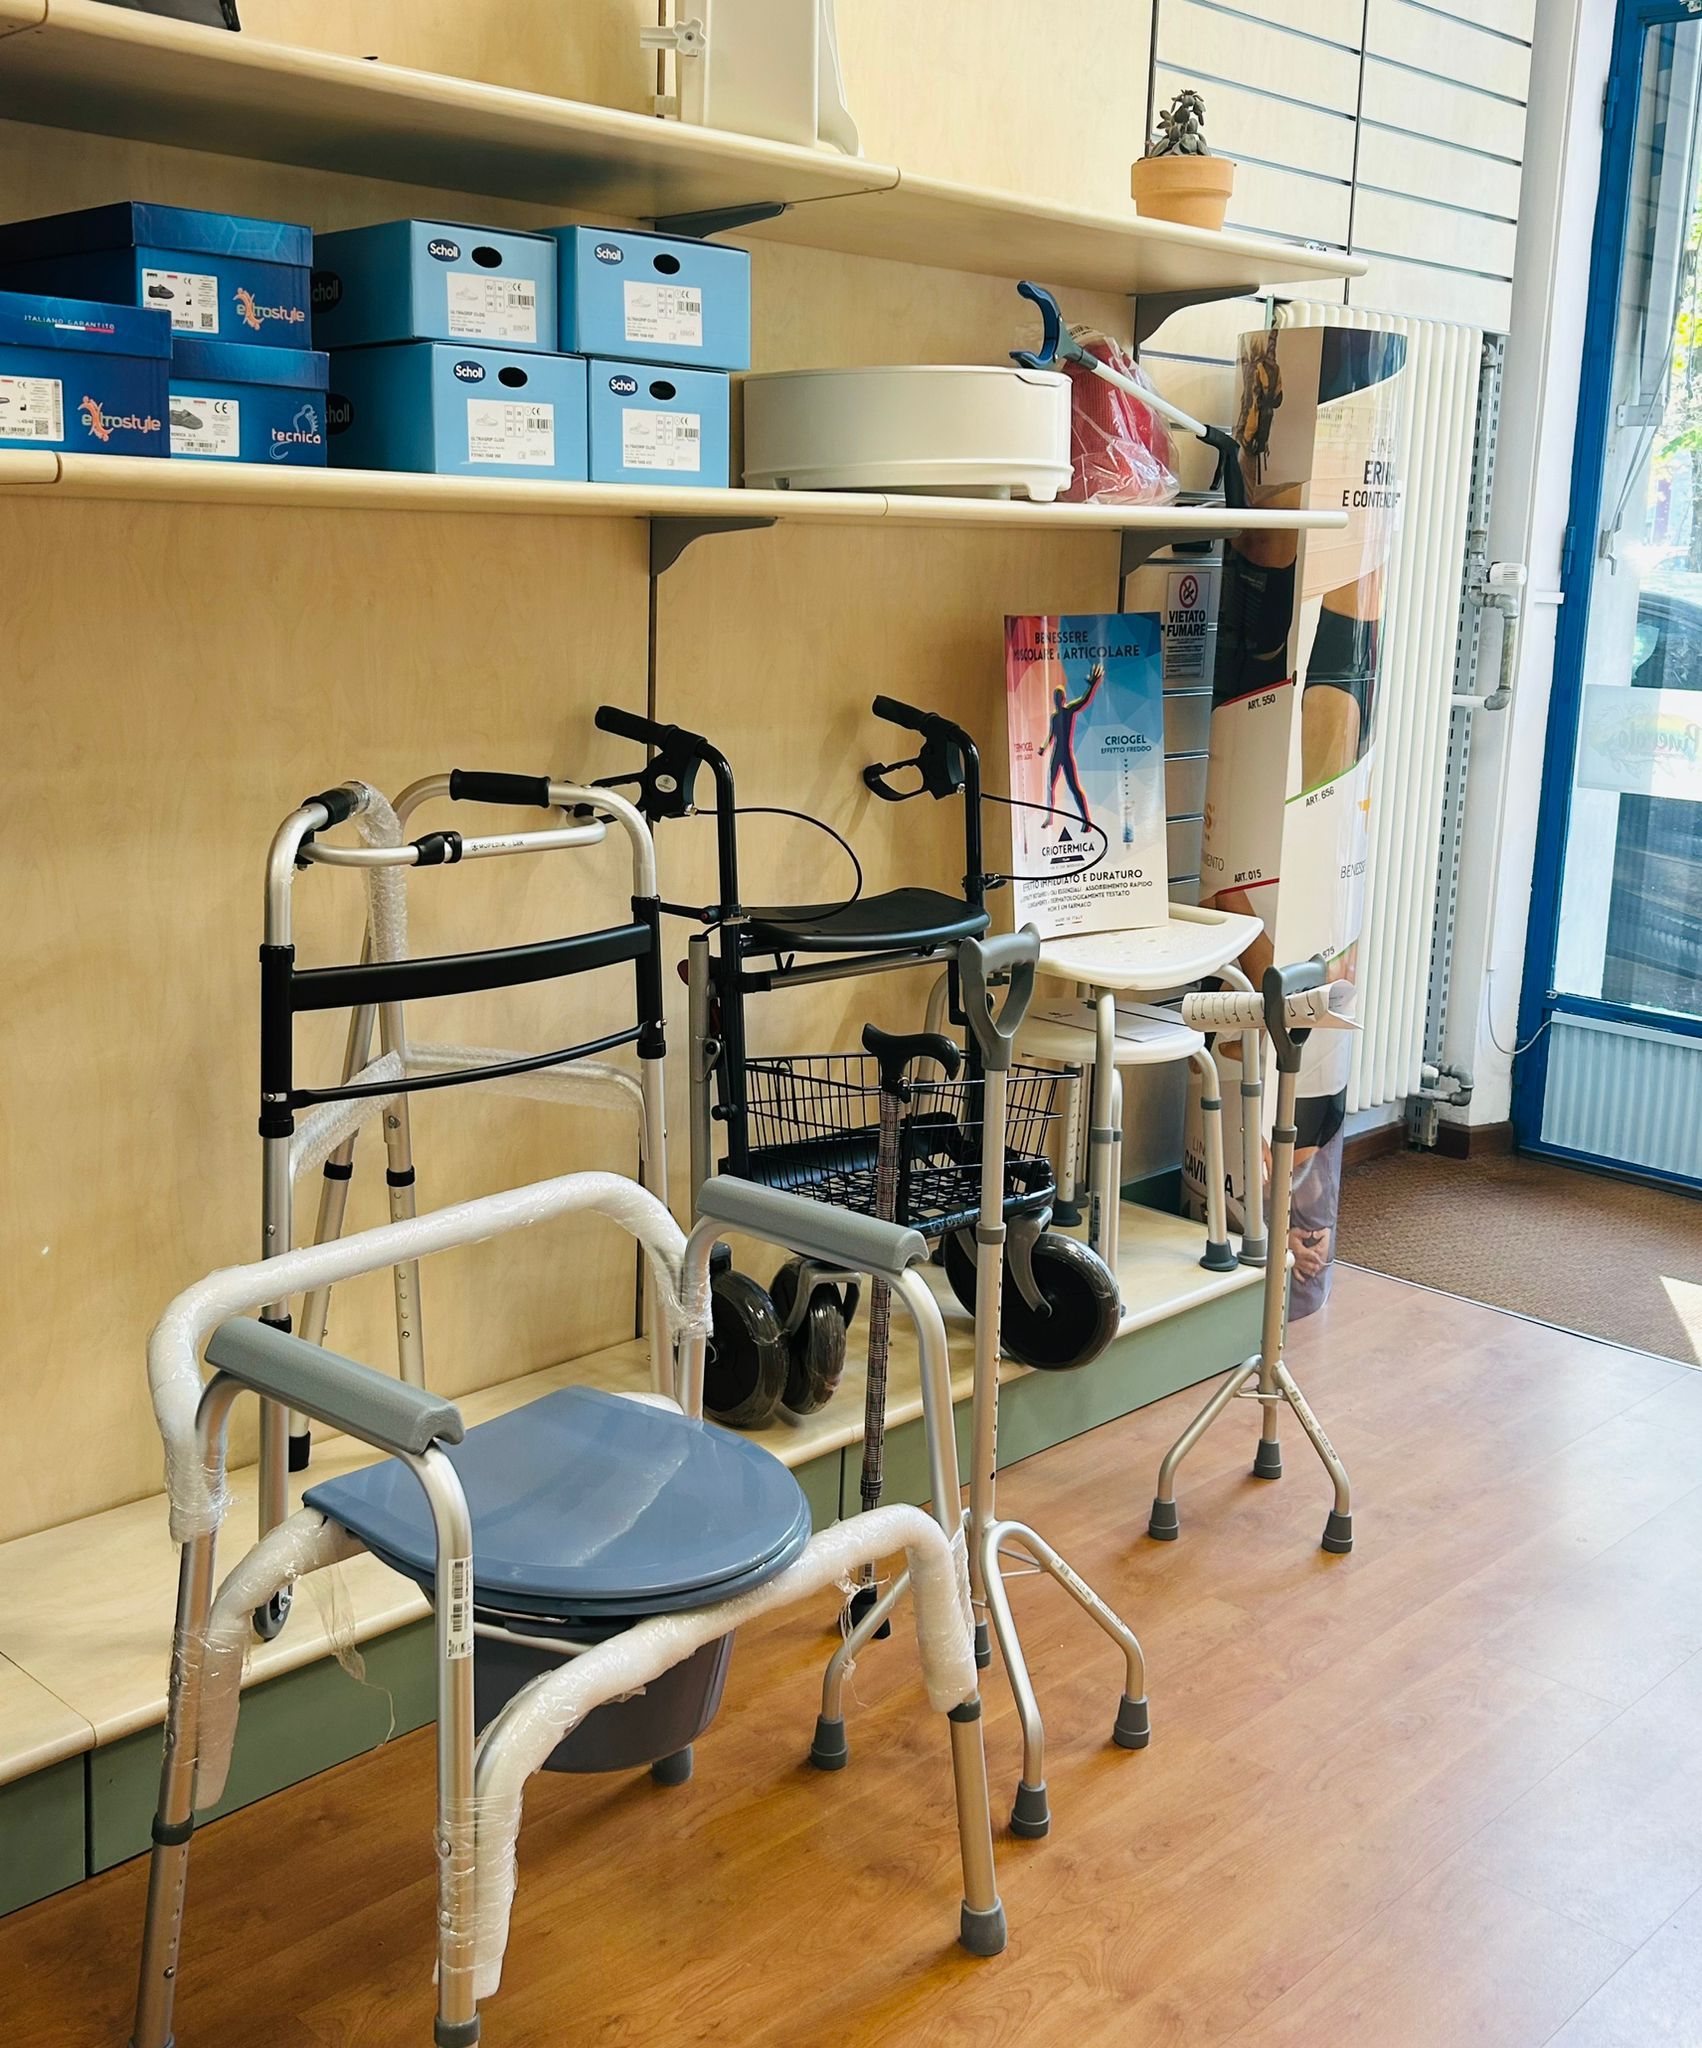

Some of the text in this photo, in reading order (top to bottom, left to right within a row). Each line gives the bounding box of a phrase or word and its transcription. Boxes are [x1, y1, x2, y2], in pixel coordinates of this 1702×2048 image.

[429, 243, 459, 258] Scholl
[596, 246, 622, 261] Scholl
[312, 279, 339, 302] choll
[455, 365, 484, 379] Scholl
[610, 379, 636, 393] Scholl
[327, 402, 350, 424] holl
[271, 427, 321, 445] tecnica
[1342, 490, 1350, 507] E
[1169, 609, 1206, 623] VIETATO
[1166, 623, 1206, 637] FUMARE
[1035, 631, 1088, 645] BENESSERE
[1063, 644, 1140, 660] ARTICOLARE
[1248, 693, 1276, 711] ART. 550
[1105, 734, 1147, 746] CRIOGEL
[1321, 785, 1335, 800] 656
[1041, 842, 1095, 857] CRIOTERMICA
[1082, 873, 1087, 882] E
[1090, 869, 1143, 882] DURATURO
[1234, 868, 1262, 883] ART. 015
[1085, 882, 1128, 891] ASSORBIMENTO
[1129, 880, 1153, 888] RAPIDO
[1106, 890, 1130, 898] TESTATO
[1322, 945, 1335, 959] 575
